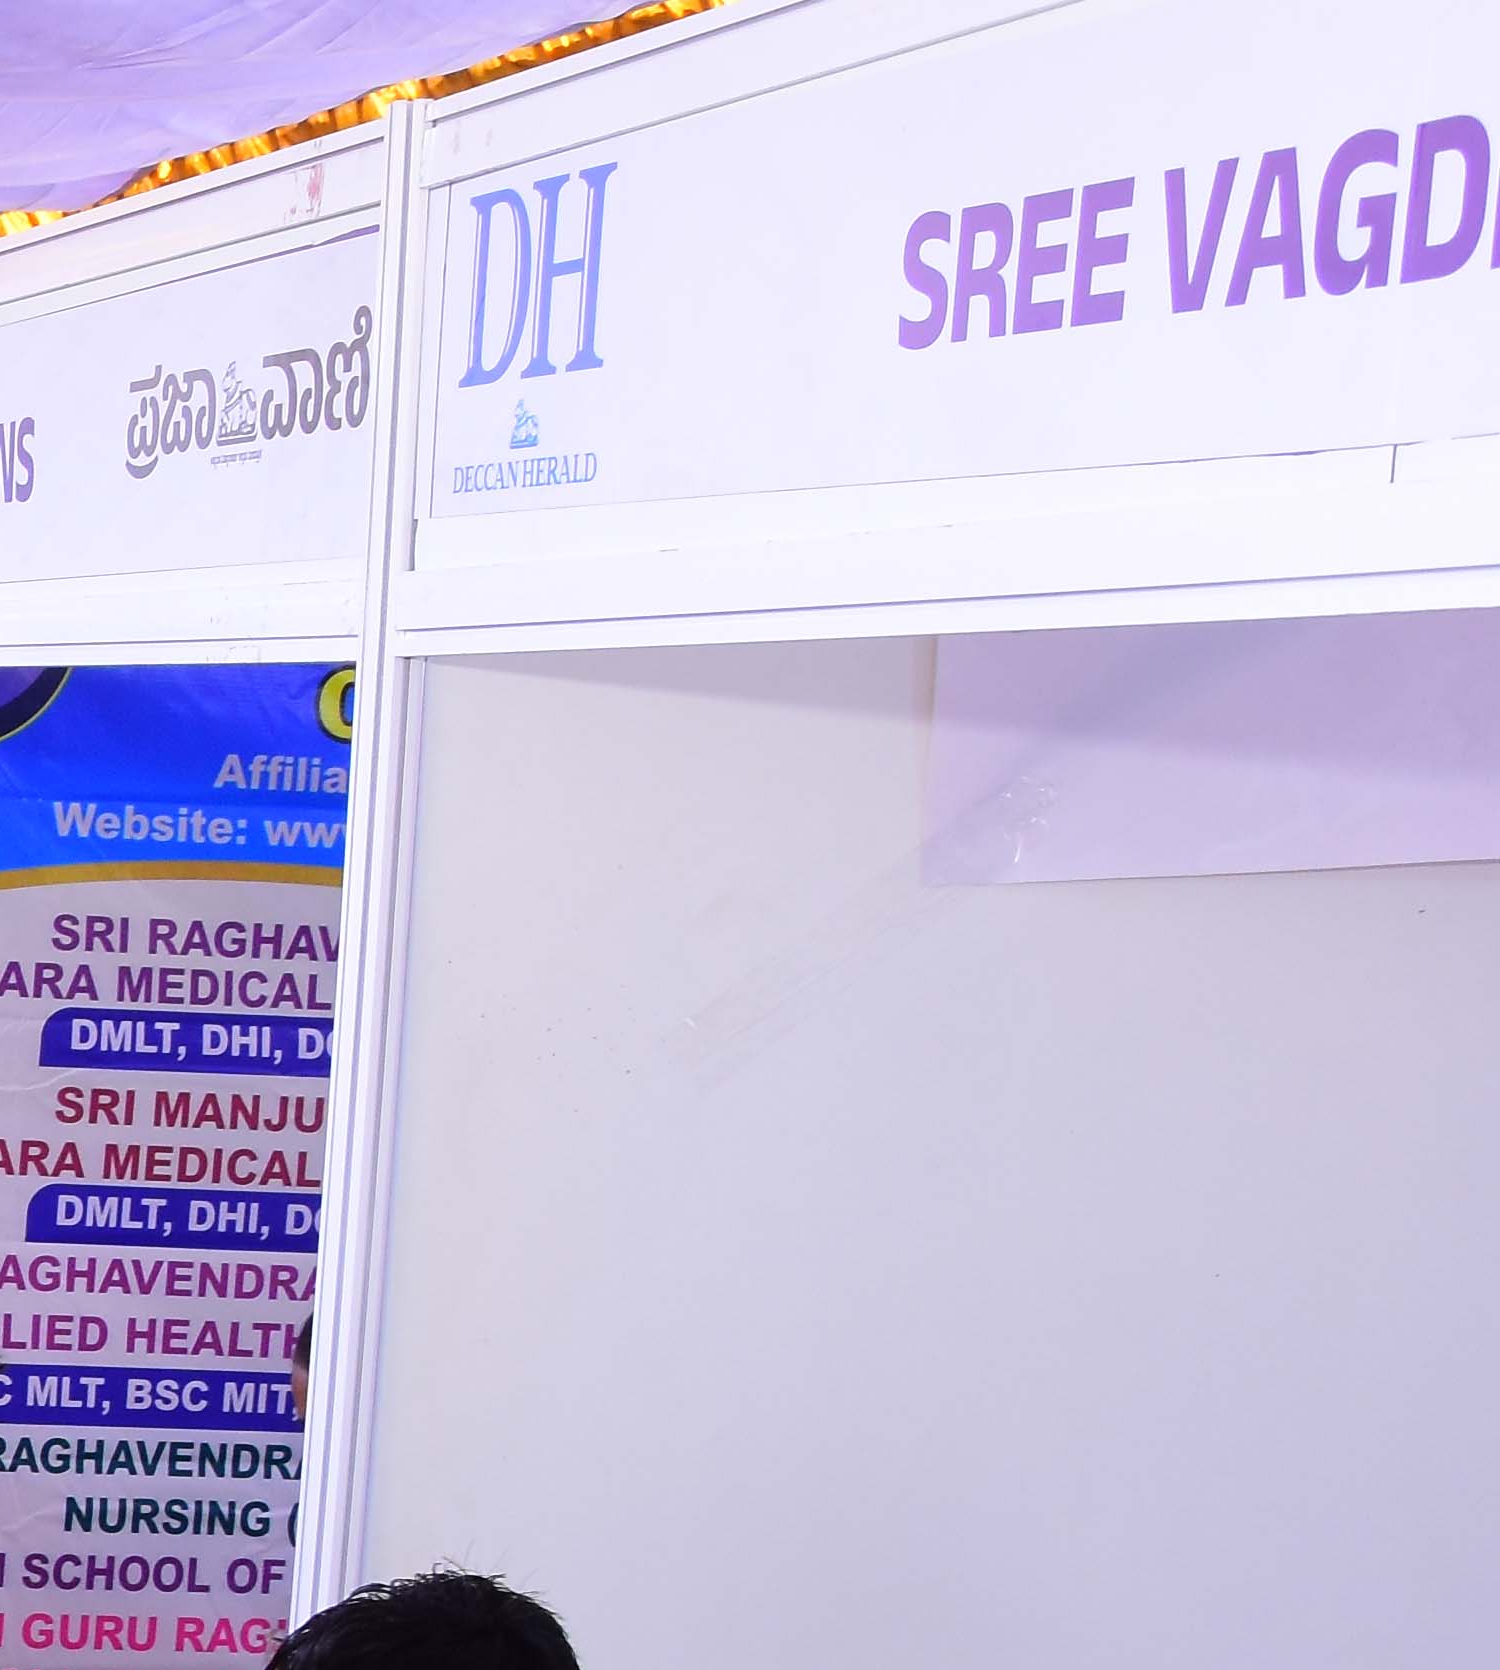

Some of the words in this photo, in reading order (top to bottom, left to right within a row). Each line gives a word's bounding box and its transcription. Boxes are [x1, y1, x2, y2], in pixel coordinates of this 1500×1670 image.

[899, 175, 1135, 351] SREE
[1164, 114, 1500, 317] VAGD
[456, 161, 618, 390] DH
[452, 457, 520, 495] DECCAN
[520, 452, 598, 489] HERALD
[53, 802, 248, 845] Website:
[266, 818, 347, 849] ww
[52, 914, 129, 953] SRI
[117, 967, 332, 1010] MEDICAL
[71, 1019, 188, 1061] DMLT,
[202, 1023, 282, 1066] DHI,
[297, 1028, 333, 1060] D
[56, 1086, 134, 1126] SRI
[154, 1091, 324, 1133] MANJU
[103, 1144, 320, 1187] MEDICAL
[56, 1195, 172, 1236] DMLT,
[189, 1201, 269, 1240] DHI,
[27, 1376, 110, 1414] MLT,
[126, 1379, 208, 1412] BSC
[64, 1497, 270, 1537] NURSING
[22, 1553, 211, 1593] SCHOOL
[226, 1558, 286, 1595] OF
[22, 1613, 157, 1651] GURU
[175, 1616, 286, 1653] RAG
